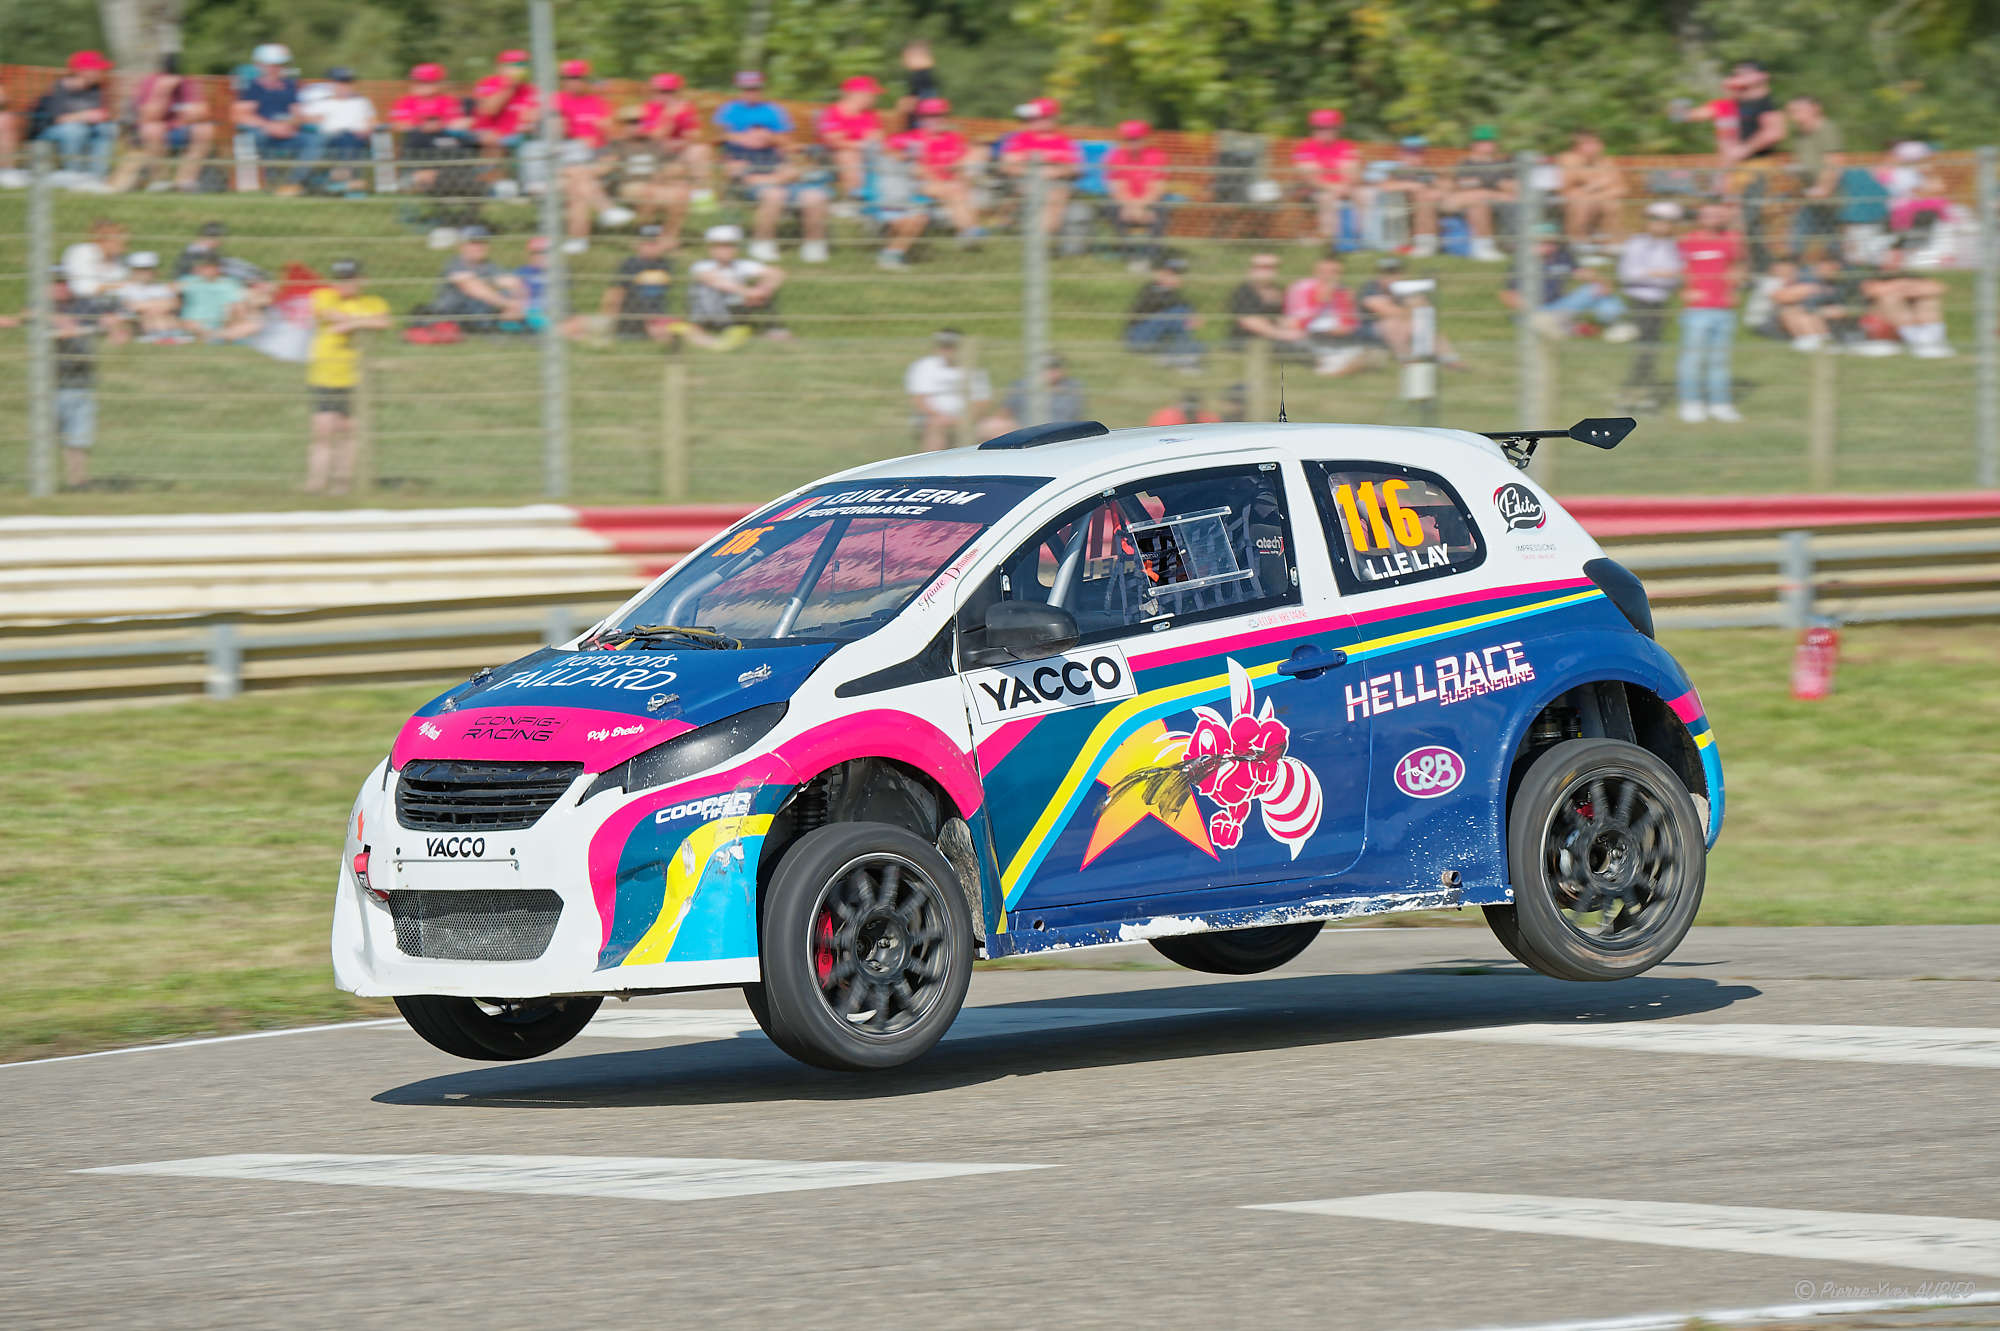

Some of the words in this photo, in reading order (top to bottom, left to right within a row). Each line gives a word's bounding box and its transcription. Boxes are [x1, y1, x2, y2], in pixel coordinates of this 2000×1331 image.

[826, 488, 986, 505] GUILLERM
[799, 505, 932, 519] PERFORMANCE
[1336, 479, 1425, 552] 116
[711, 525, 775, 557] 116
[1411, 543, 1450, 571] LAY
[485, 667, 678, 691] TAILLARD
[978, 656, 1122, 711] YACCO
[1344, 641, 1534, 722] HELLRACE
[1439, 677, 1536, 706] SUSPENSIONS
[461, 728, 553, 742] RACING
[426, 837, 485, 858] YACCO
